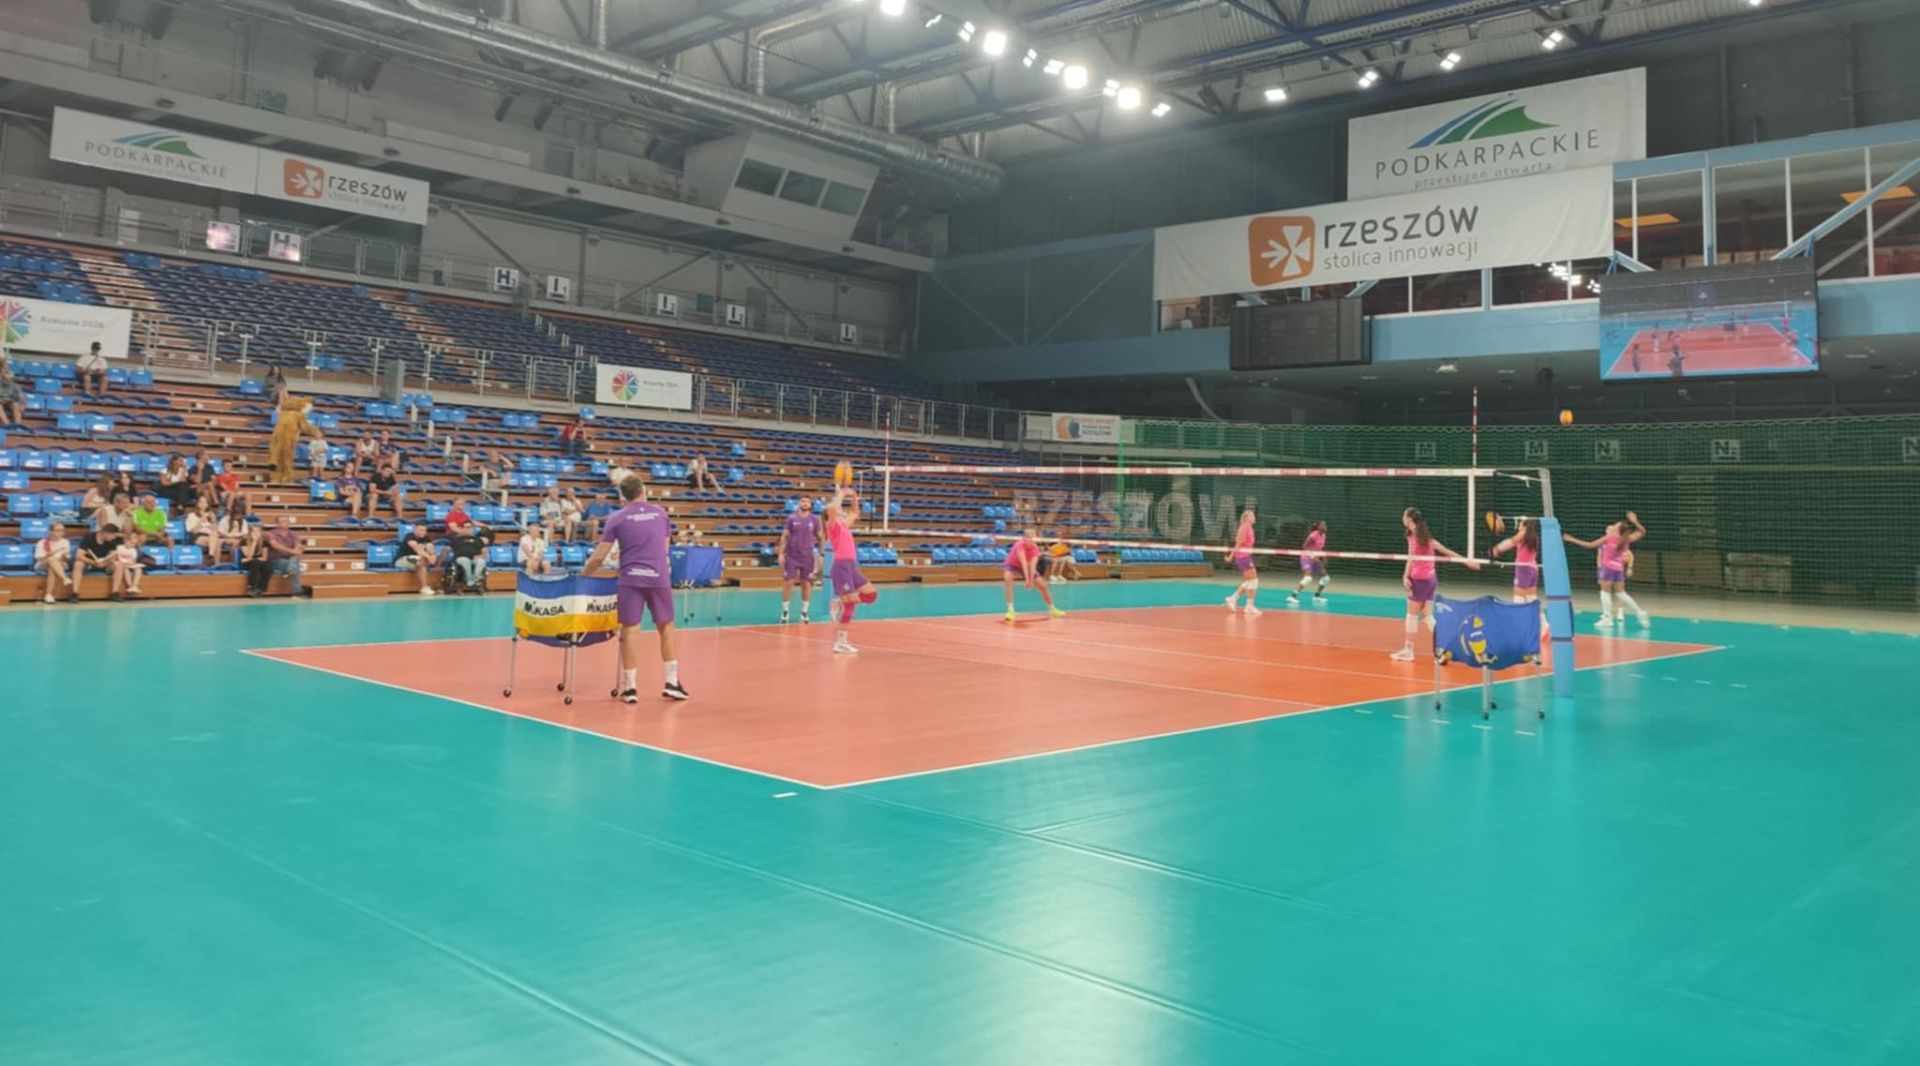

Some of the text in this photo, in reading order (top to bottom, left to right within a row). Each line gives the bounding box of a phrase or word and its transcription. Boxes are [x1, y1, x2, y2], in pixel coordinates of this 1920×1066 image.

[85, 141, 229, 178] PODKARPACKIE
[1375, 129, 1599, 180] PODKARPACKIE
[328, 175, 407, 203] rzeszów
[1414, 161, 1553, 189] przestrzeń otwarta
[1324, 205, 1479, 249] rzeszów
[1324, 237, 1479, 270] stolica innowacji
